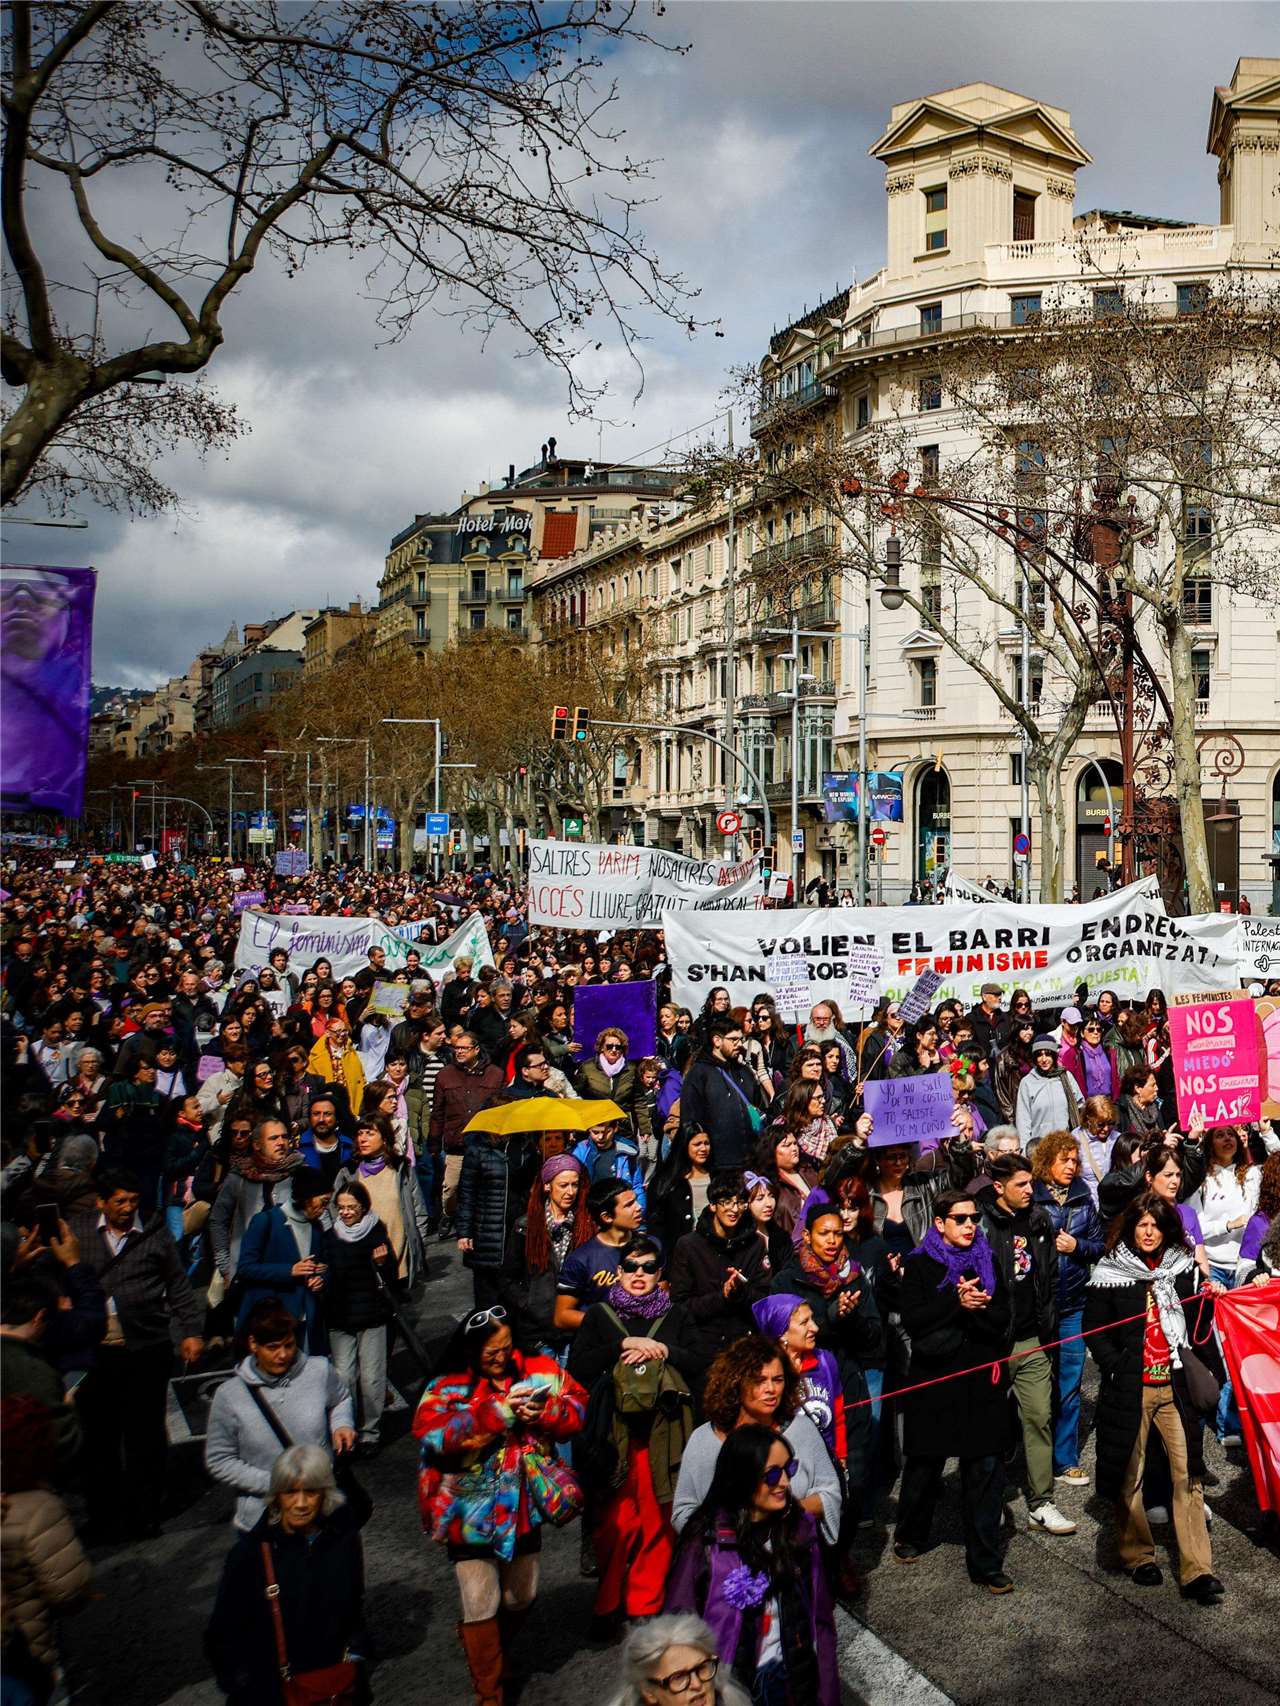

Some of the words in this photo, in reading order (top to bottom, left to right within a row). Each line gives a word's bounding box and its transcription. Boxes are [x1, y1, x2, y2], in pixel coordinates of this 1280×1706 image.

[456, 515, 494, 536] Hotel
[598, 851, 640, 880] PARIM,
[528, 885, 584, 919] ACCÉS
[589, 889, 634, 923] LLIURE,
[757, 934, 876, 957] VOLIEN
[891, 931, 934, 955] EL
[949, 926, 1051, 951] BARRI
[687, 963, 766, 983] S'HAN
[897, 949, 1049, 976] FEMINISME
[1175, 994, 1190, 1005] LES
[1192, 992, 1233, 1003] FEMINISTES
[1186, 1006, 1234, 1036] NOS
[1183, 1055, 1231, 1072] MIEDO
[903, 1083, 915, 1093] NO
[1179, 1074, 1217, 1097] NOS
[891, 1096, 900, 1107] DE
[1188, 1098, 1240, 1125] ALAS
[896, 1124, 906, 1137] DE
[909, 1123, 918, 1134] MI
